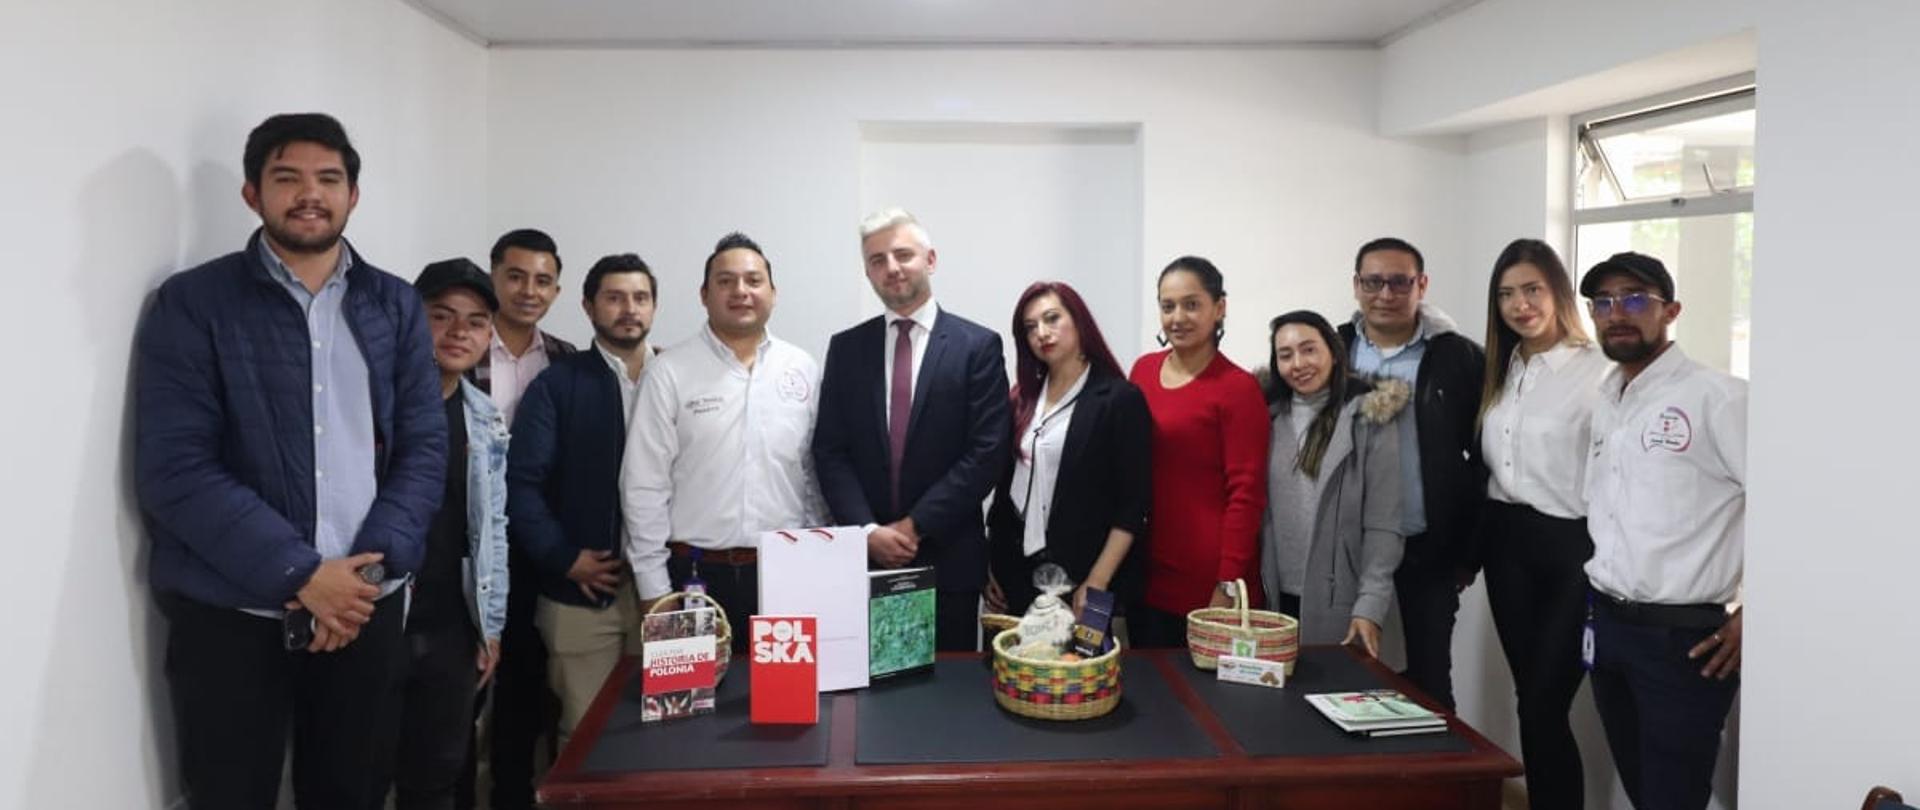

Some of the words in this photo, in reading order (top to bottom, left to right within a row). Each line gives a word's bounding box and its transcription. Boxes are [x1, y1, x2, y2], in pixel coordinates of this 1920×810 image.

[754, 620, 812, 642] POL
[650, 655, 695, 667] HISTORIA
[696, 652, 709, 662] DE
[754, 642, 815, 664] SKA
[650, 665, 694, 677] POLONIA
